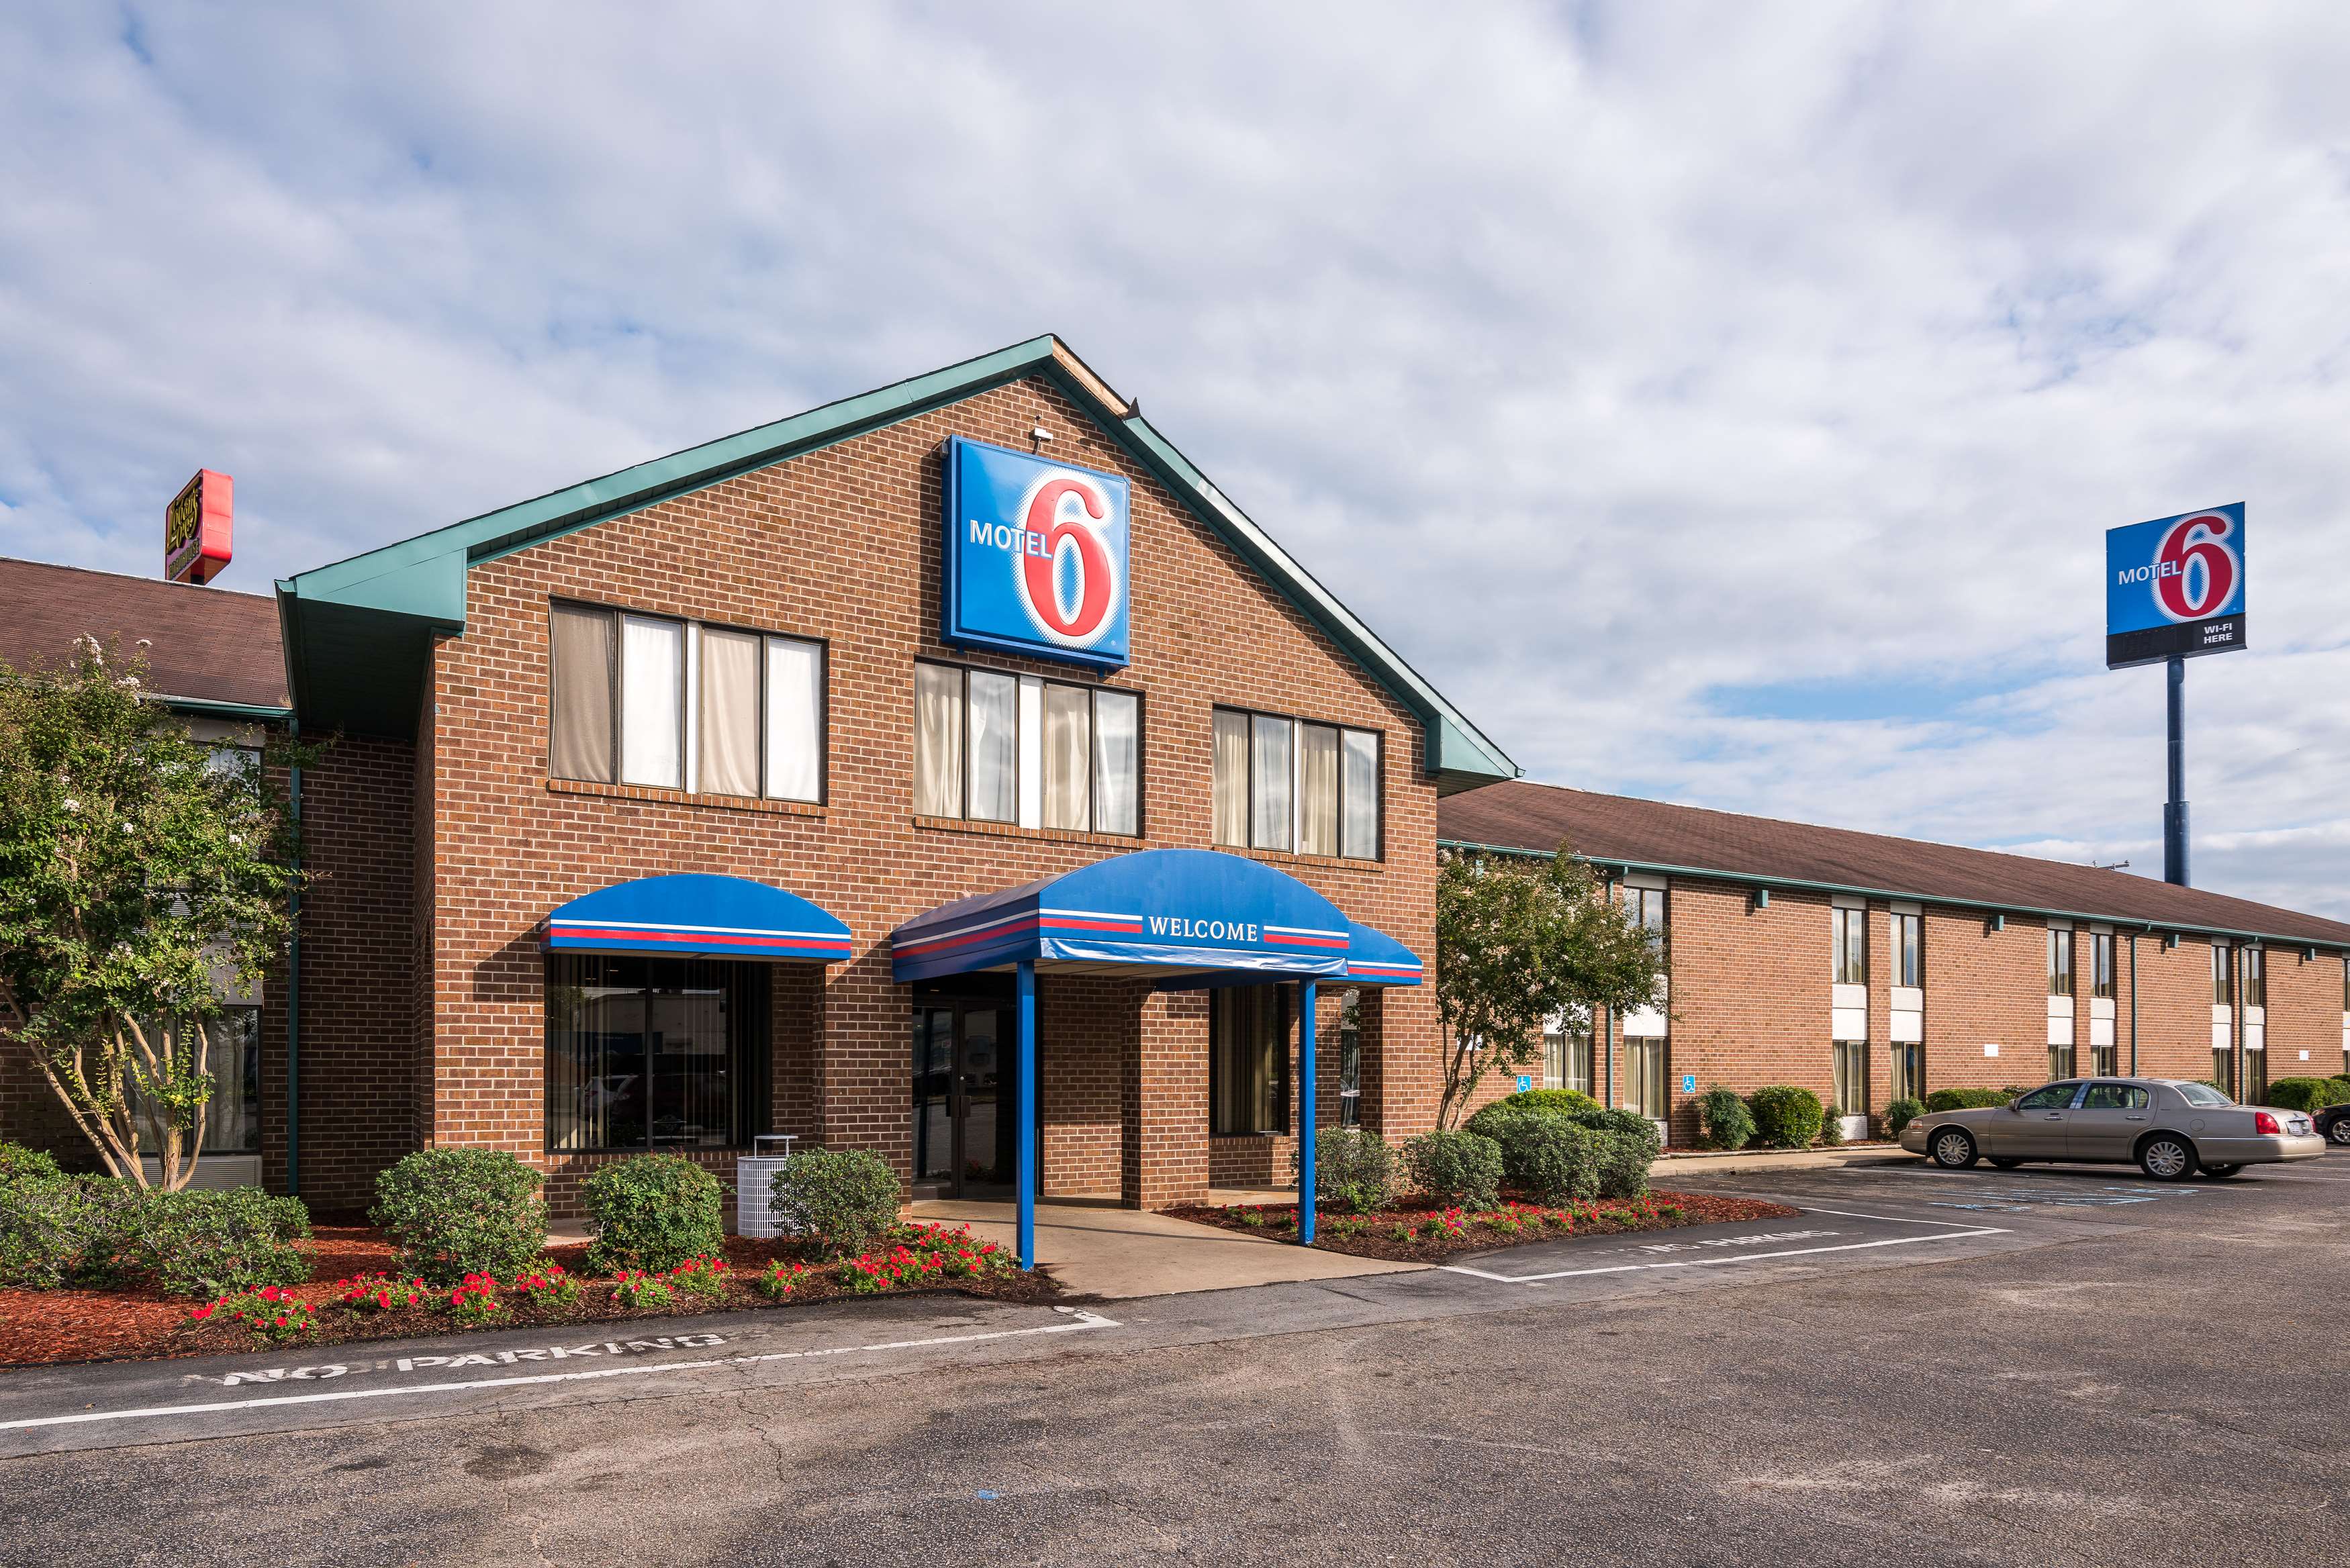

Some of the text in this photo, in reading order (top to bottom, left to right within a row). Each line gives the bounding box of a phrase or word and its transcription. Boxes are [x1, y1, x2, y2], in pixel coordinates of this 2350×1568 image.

[970, 479, 1111, 637] MOTEL 6
[2118, 516, 2232, 618] MOTEL 6
[2204, 623, 2232, 634] WI-FI
[2204, 633, 2233, 644] HERE
[1148, 916, 1258, 942] WELCOME
[1639, 1243, 1702, 1253] NO
[1695, 1230, 1840, 1246] PARKING
[222, 1334, 727, 1386] NO PARKING
